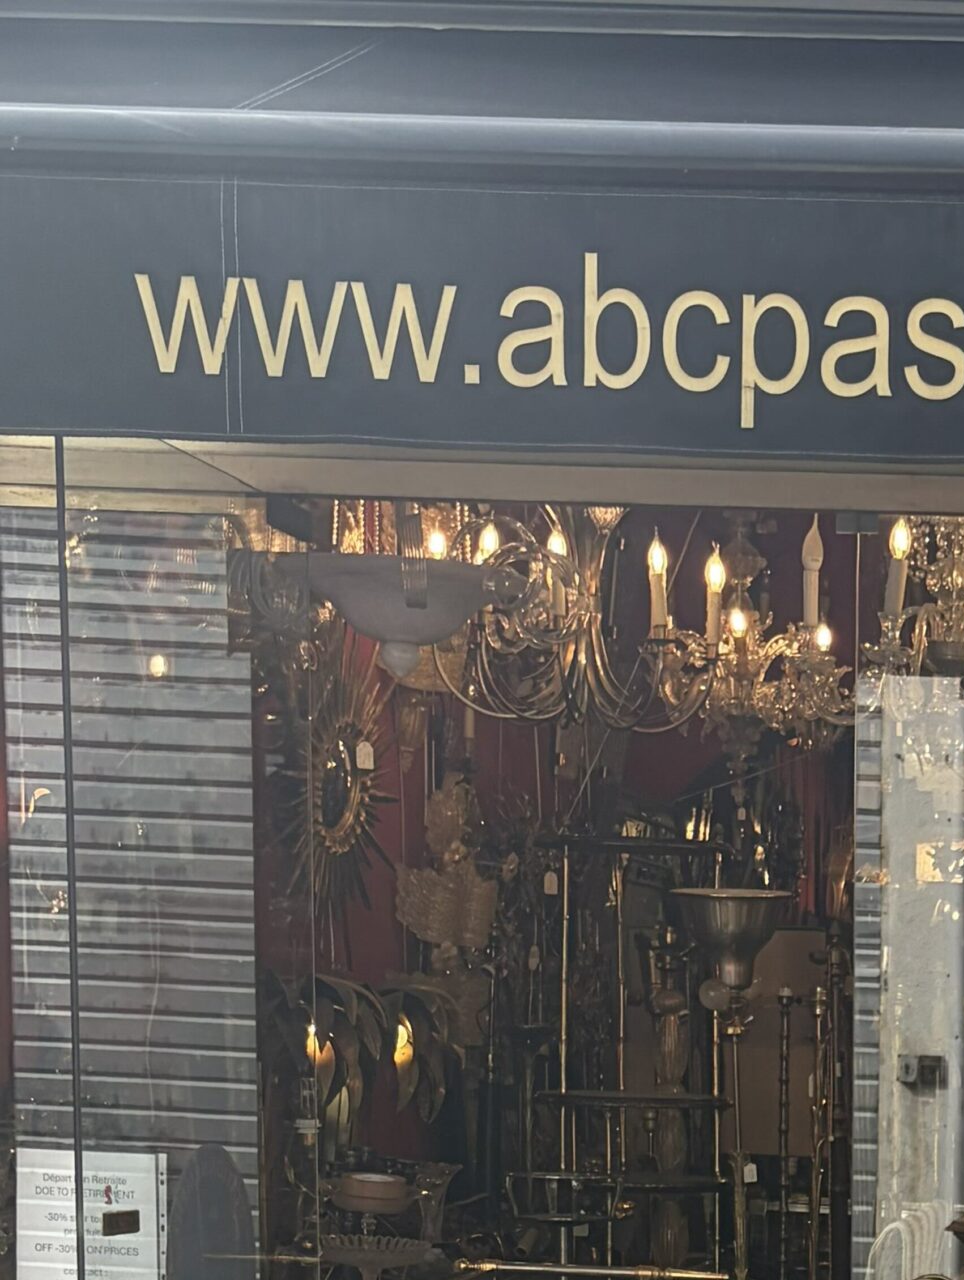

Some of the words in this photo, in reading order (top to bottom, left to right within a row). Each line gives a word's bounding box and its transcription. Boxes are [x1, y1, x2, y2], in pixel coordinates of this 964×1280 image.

[43, 1173, 72, 1183] Départ
[57, 1187, 69, 1197] TO
[35, 1243, 53, 1252] OFF
[104, 1246, 139, 1257] PRICES
